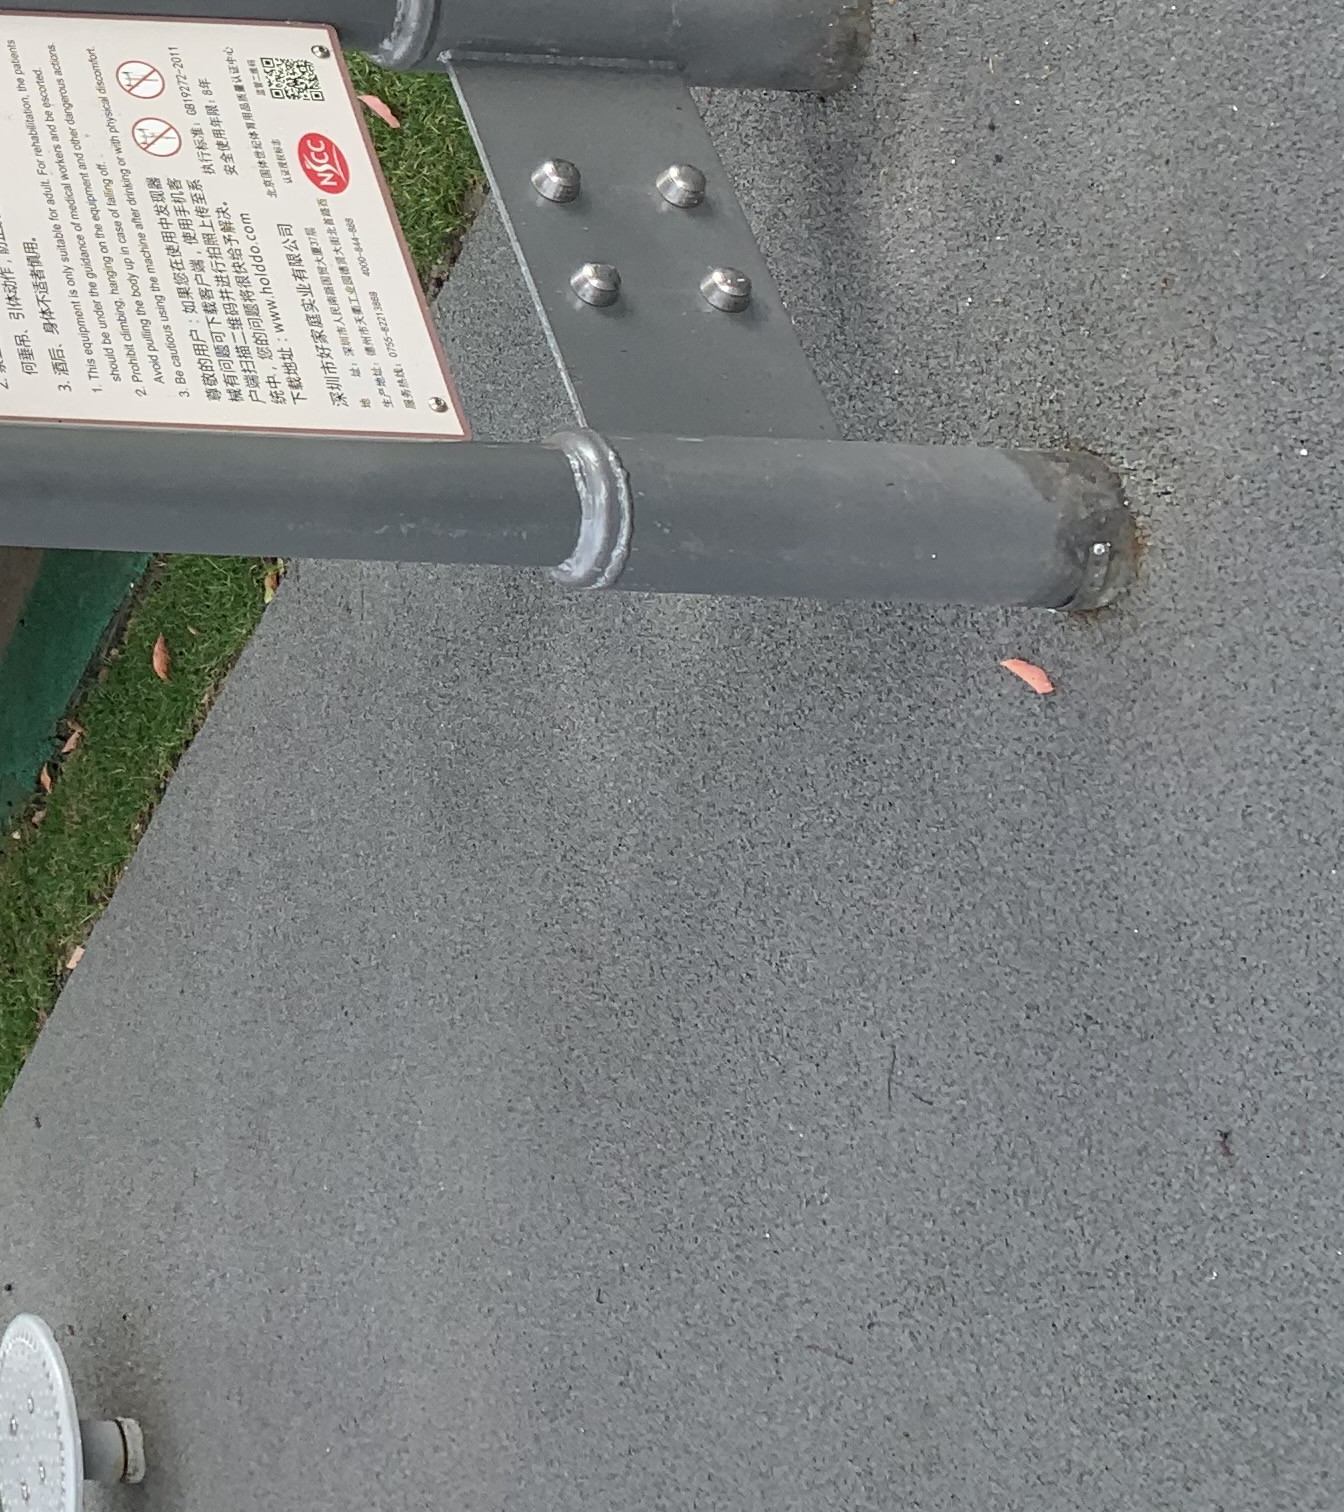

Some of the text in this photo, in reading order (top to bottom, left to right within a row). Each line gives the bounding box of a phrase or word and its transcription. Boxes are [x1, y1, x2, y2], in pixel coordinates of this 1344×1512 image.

[6, 40, 25, 76] patients
[15, 78, 27, 92] the
[55, 78, 75, 126] dangerous
[44, 110, 54, 123] be
[97, 97, 120, 134] physical
[45, 124, 59, 143] and
[68, 127, 82, 151] other
[109, 136, 122, 155] with
[36, 159, 52, 176] For
[52, 144, 69, 181] workers
[72, 152, 87, 171] and
[115, 156, 126, 167] or
[78, 172, 101, 222] equipment
[102, 179, 117, 207] falling
[119, 169, 137, 206] drinking
[60, 183, 79, 220] medical
[47, 207, 59, 222] for
[107, 208, 120, 219] of
[130, 208, 144, 231] after
[69, 222, 83, 232] of
[93, 224, 105, 239] the
[113, 221, 127, 244] case
[51, 224, 70, 263] suitable
[98, 241, 109, 254] on
[119, 246, 129, 256] in
[137, 232, 156, 274] machine
[75, 234, 97, 280] guidance
[123, 258, 135, 271] up
[61, 265, 76, 287] only
[102, 256, 119, 296] hanging
[126, 273, 141, 298] body
[148, 276, 161, 292] the
[67, 289, 79, 299] is
[87, 282, 99, 298] the
[92, 300, 108, 330] under
[134, 300, 147, 316] the
[153, 295, 169, 322] using
[276, 224, 349, 408] 深圳市好家庭实业有限公司
[70, 301, 93, 356] equipment
[100, 332, 112, 345] be
[139, 319, 159, 352] pulling
[162, 324, 181, 368] cautious
[85, 358, 99, 381] This
[102, 347, 121, 383] should
[123, 344, 143, 383] Prohibit
[146, 355, 165, 385] Avoid
[57, 381, 72, 393] 3.
[174, 370, 186, 385] Be
